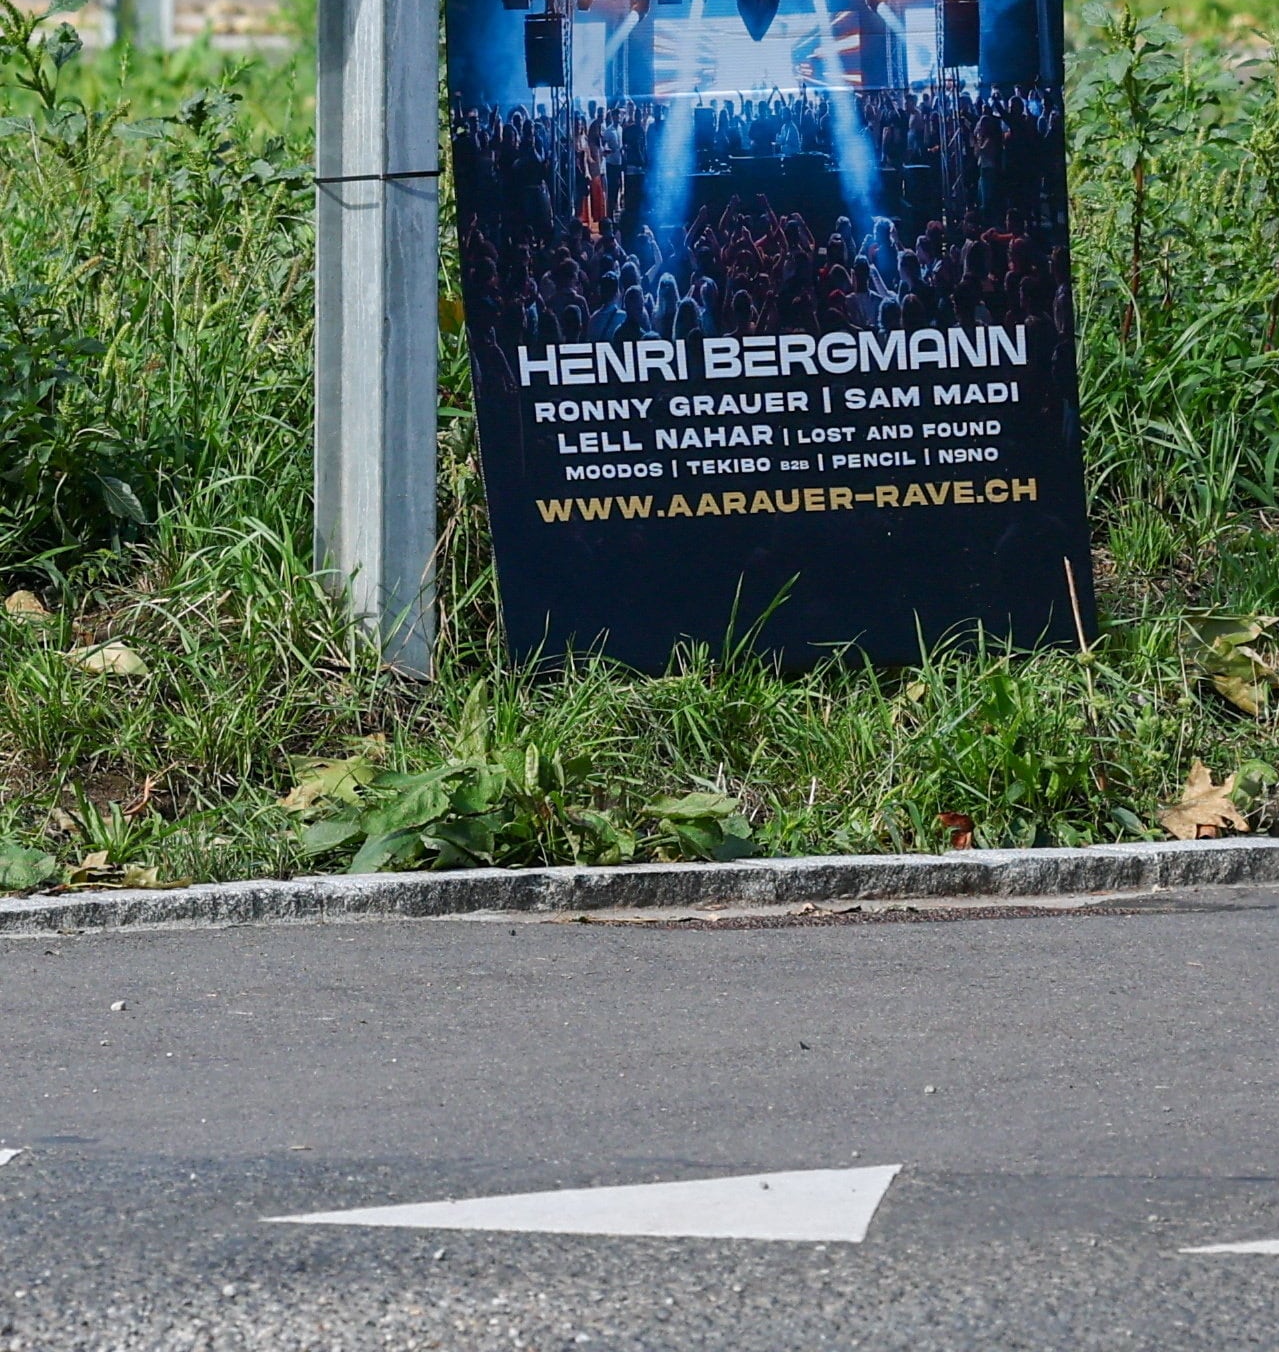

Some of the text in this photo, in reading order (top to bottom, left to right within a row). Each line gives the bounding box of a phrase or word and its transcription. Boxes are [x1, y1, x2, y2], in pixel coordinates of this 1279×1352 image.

[517, 325, 1027, 386] HENRI BERGMANN
[534, 398, 652, 423] RONNY
[669, 391, 809, 418] GRAUER
[844, 386, 920, 411] SAM
[933, 381, 1020, 406] MADI
[557, 430, 642, 455] LELL
[655, 424, 773, 450] NAHAR
[797, 427, 855, 445] LOST
[866, 424, 913, 441] AND
[922, 419, 1001, 439] FOUND
[565, 462, 663, 481] MOODOS
[686, 457, 771, 477] TEKIBO
[780, 459, 810, 472] B2B
[832, 451, 916, 470] PENCIL
[536, 477, 1038, 525] WWW.AARAUER-RAVE.CH
